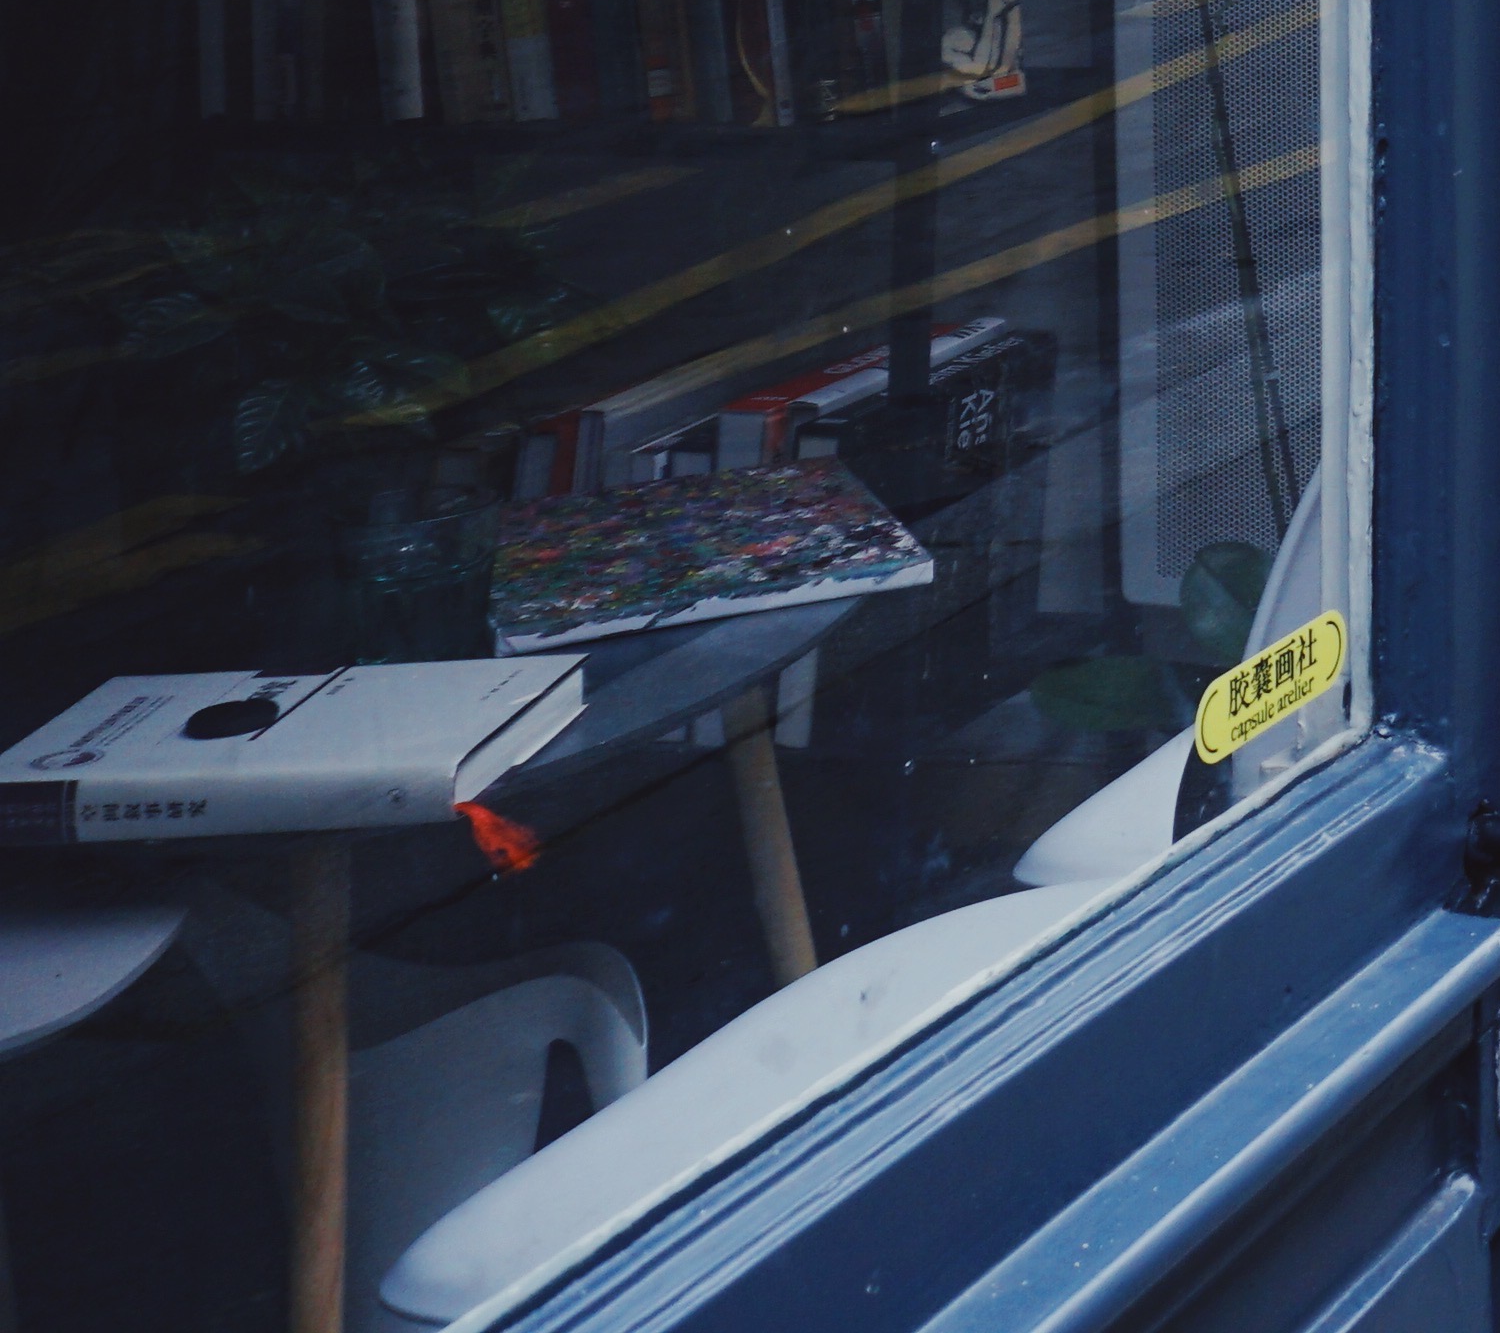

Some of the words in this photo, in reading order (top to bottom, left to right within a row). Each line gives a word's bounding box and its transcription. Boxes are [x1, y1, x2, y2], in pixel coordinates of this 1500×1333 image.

[1228, 628, 1317, 721] 胶囊画社
[1231, 700, 1275, 742] capsule
[1277, 677, 1315, 712] atelier
